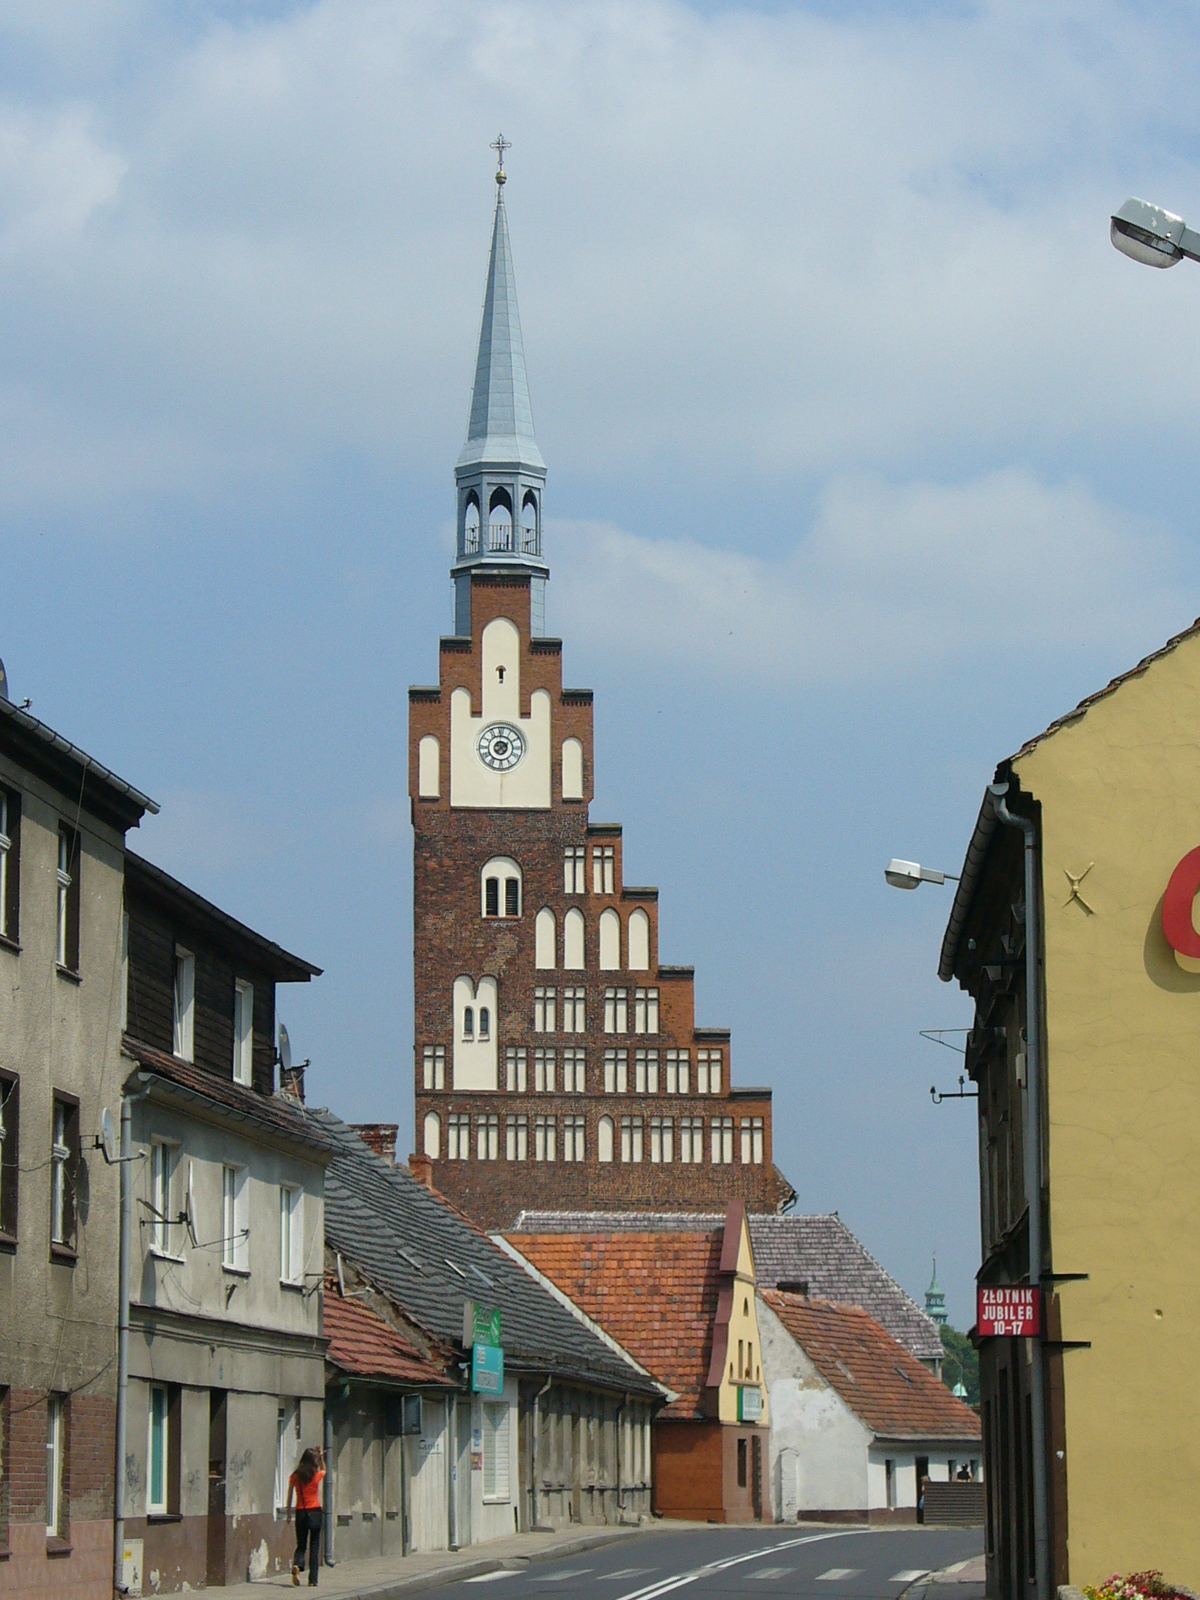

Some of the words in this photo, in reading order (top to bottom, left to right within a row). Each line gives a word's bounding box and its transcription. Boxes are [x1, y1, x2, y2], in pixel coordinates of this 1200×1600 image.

[982, 1289, 1033, 1304] ZŁOTNIK
[982, 1305, 1033, 1320] JUBILER
[993, 1321, 1023, 1335] 10-17
